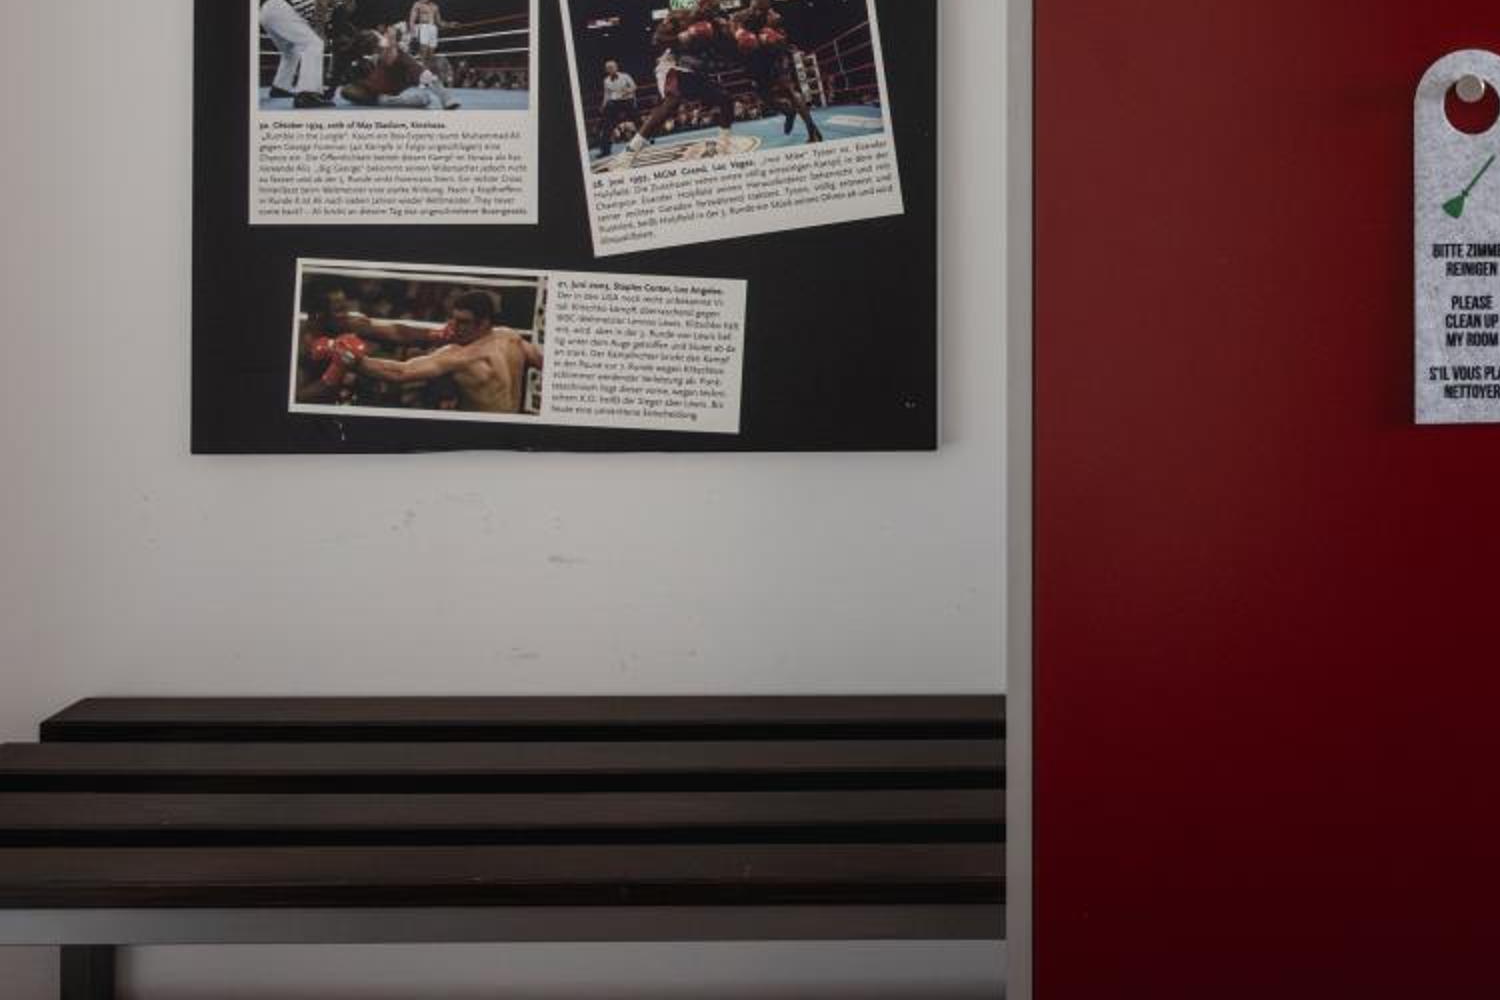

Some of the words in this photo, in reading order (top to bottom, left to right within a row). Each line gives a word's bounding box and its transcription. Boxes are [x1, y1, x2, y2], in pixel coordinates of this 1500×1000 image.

[1432, 243, 1465, 259] BITTE
[1445, 261, 1498, 277] REINIGEN
[1451, 295, 1494, 311] PLEASE
[1445, 313, 1482, 329] CLEAN
[1483, 313, 1499, 329] UP
[1446, 331, 1464, 347] MY
[1466, 331, 1499, 347] ROOM
[1452, 365, 1483, 381] VOUS
